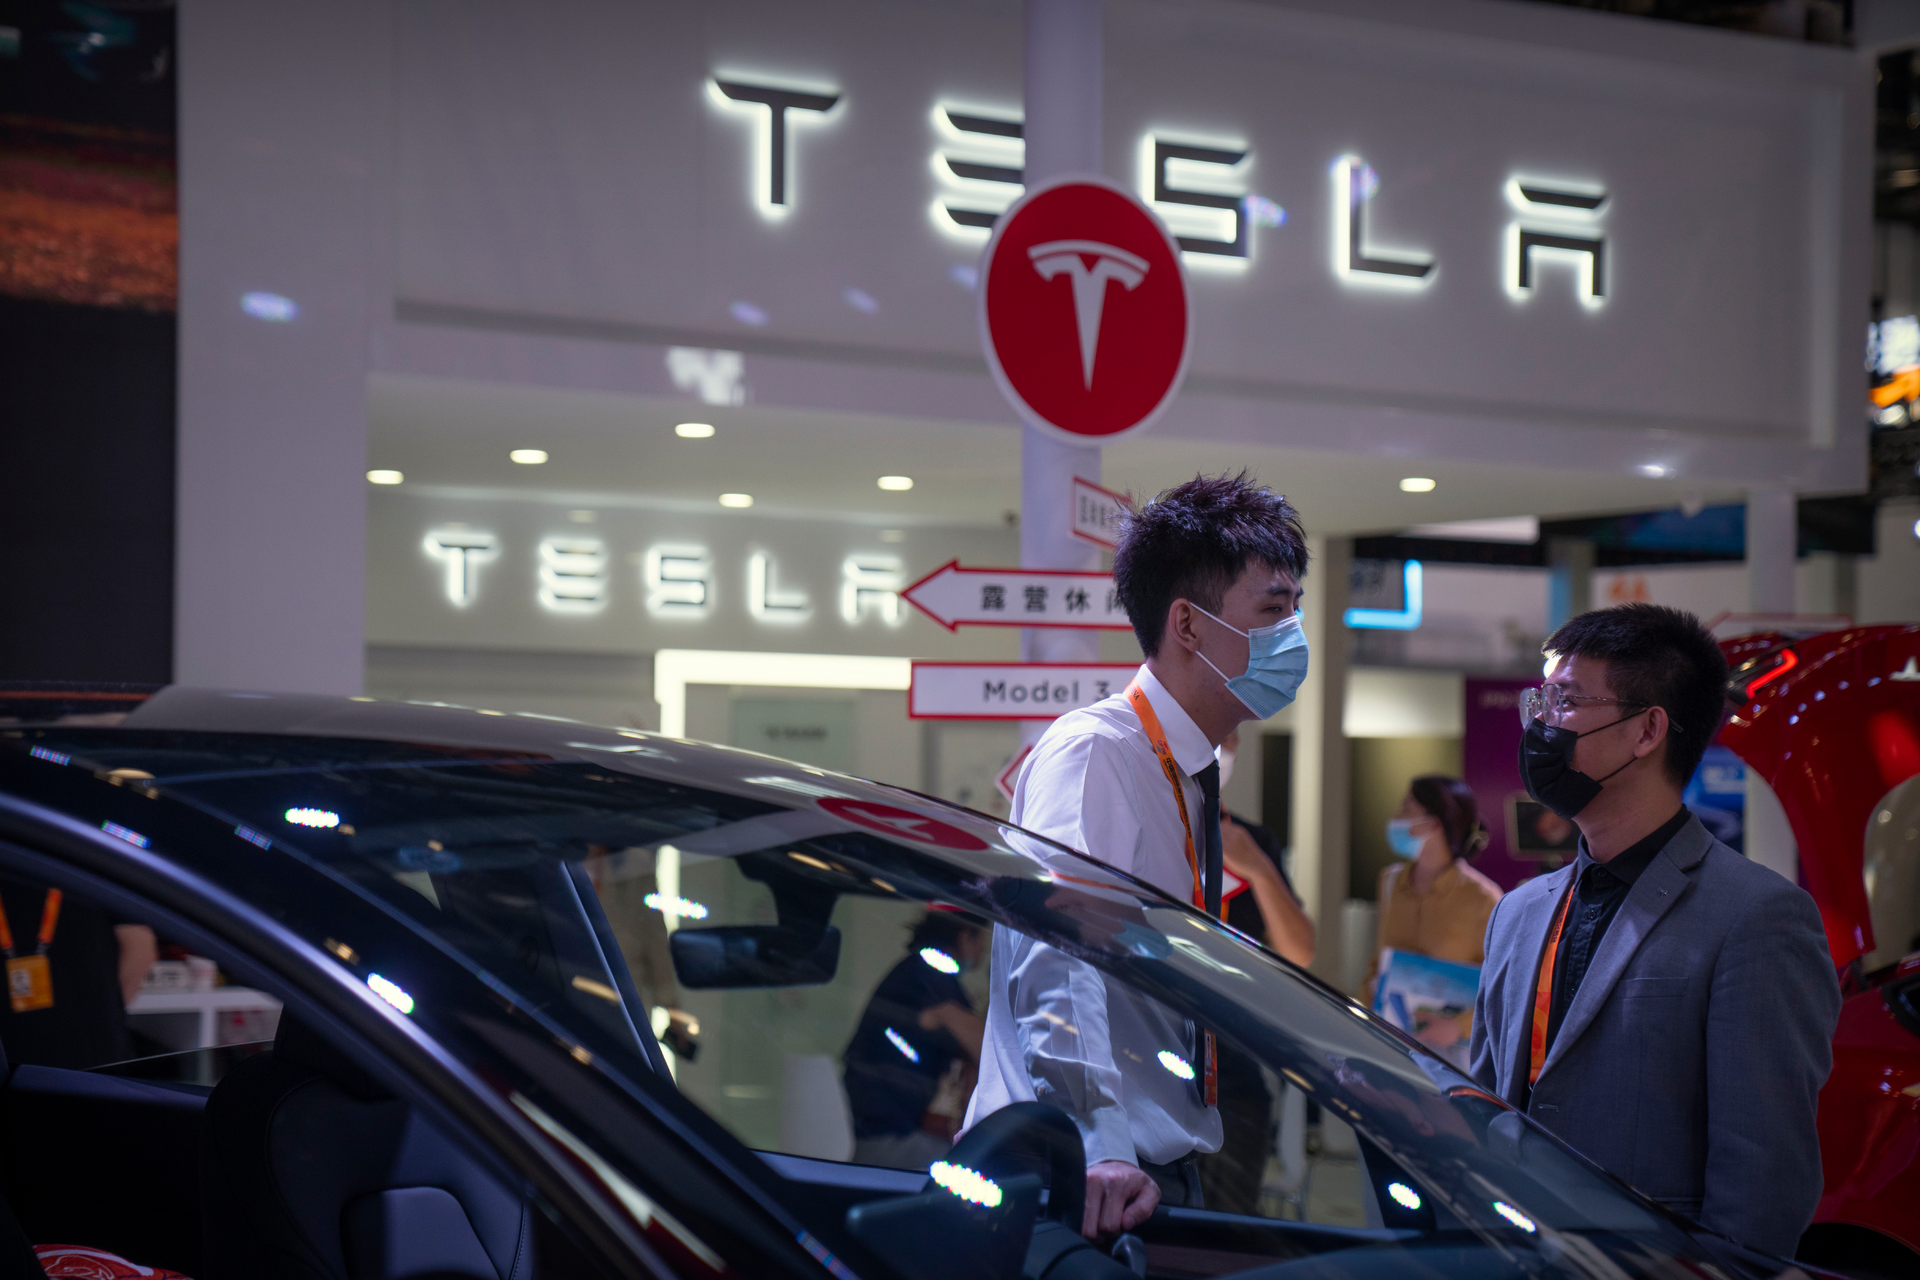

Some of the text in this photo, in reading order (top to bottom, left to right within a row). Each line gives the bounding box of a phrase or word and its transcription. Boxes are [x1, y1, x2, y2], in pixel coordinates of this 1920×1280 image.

[705, 67, 1611, 307] TESLA
[424, 531, 905, 623] TESLA
[984, 680, 1110, 702] Model 3
